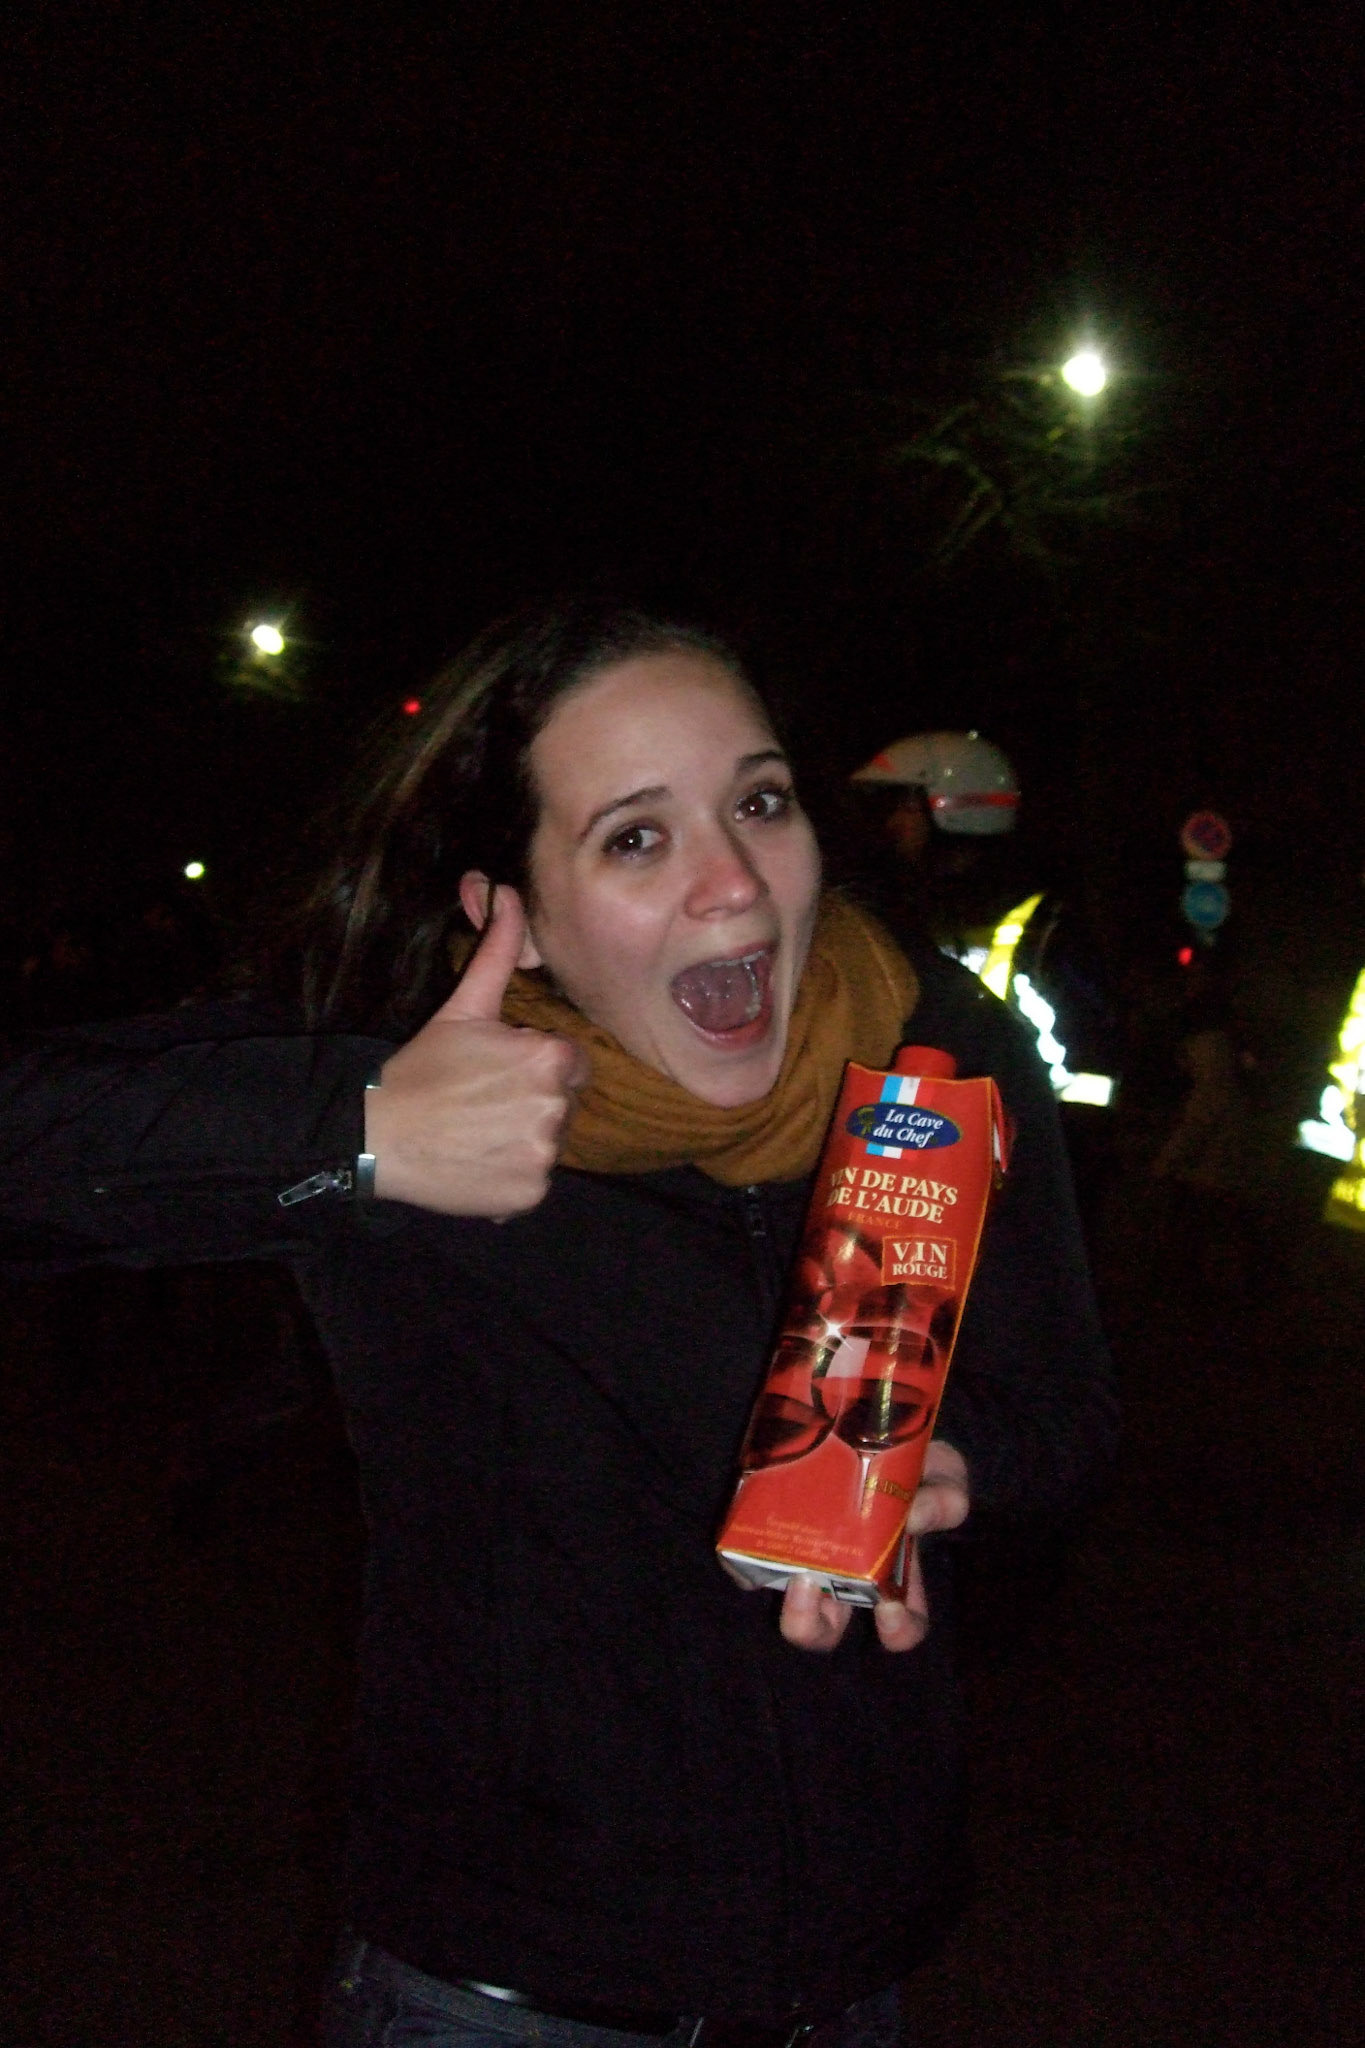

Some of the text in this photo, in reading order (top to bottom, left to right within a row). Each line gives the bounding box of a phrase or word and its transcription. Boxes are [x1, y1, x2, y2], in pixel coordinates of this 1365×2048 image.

[885, 1108, 944, 1130] La Cave
[873, 1124, 934, 1148] du Chef
[861, 1169, 896, 1192] DE
[899, 1175, 958, 1206] PAYS
[855, 1190, 944, 1224] L'AUDE
[893, 1242, 947, 1265] VIN
[892, 1261, 948, 1279] ROUGE
